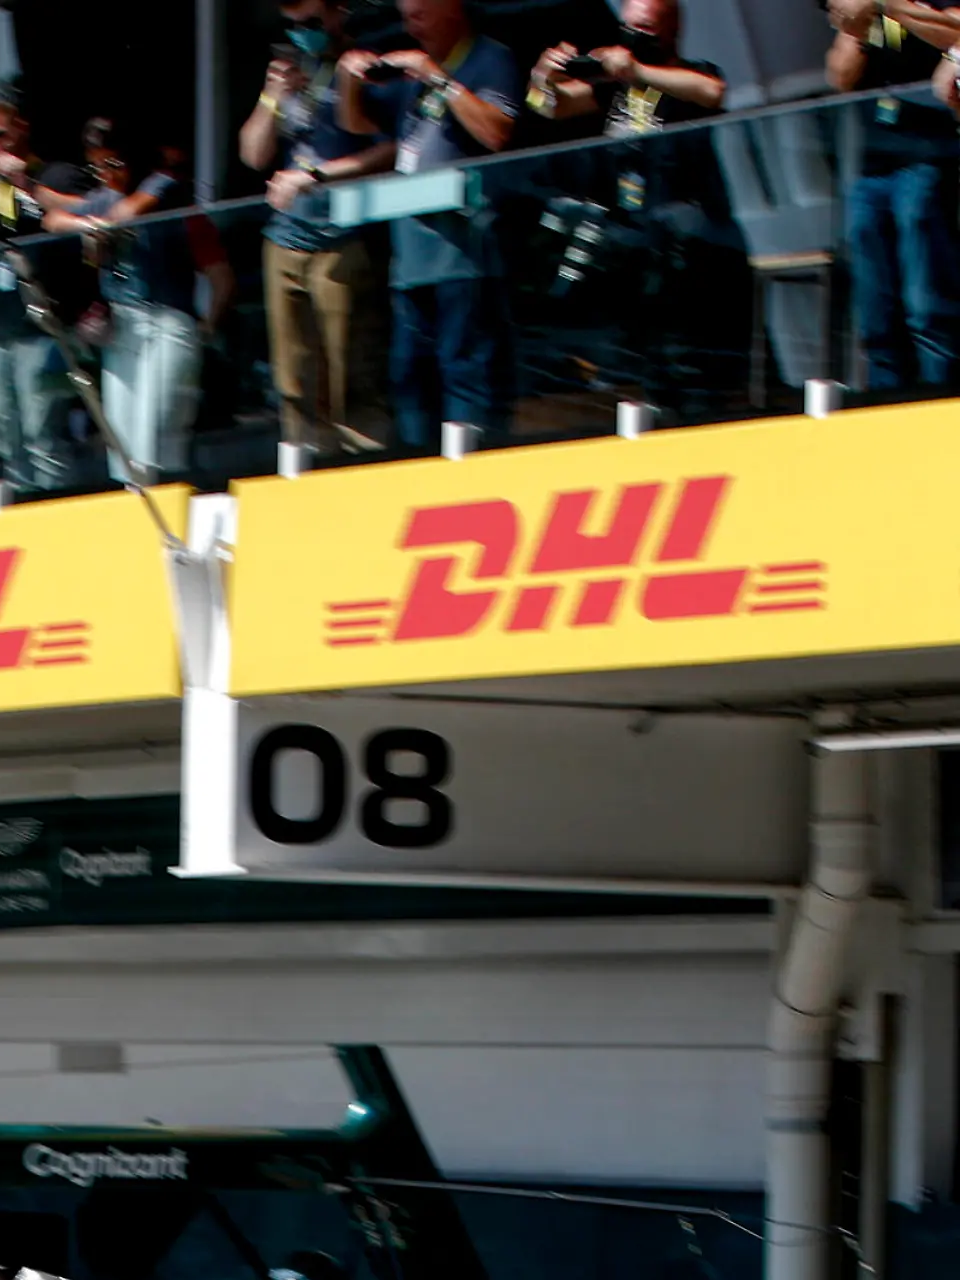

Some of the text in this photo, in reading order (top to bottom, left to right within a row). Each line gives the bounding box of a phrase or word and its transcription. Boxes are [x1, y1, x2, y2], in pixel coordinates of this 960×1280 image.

[390, 472, 752, 642] DHL
[248, 722, 453, 848] 08
[23, 1143, 189, 1187] Cognizant
